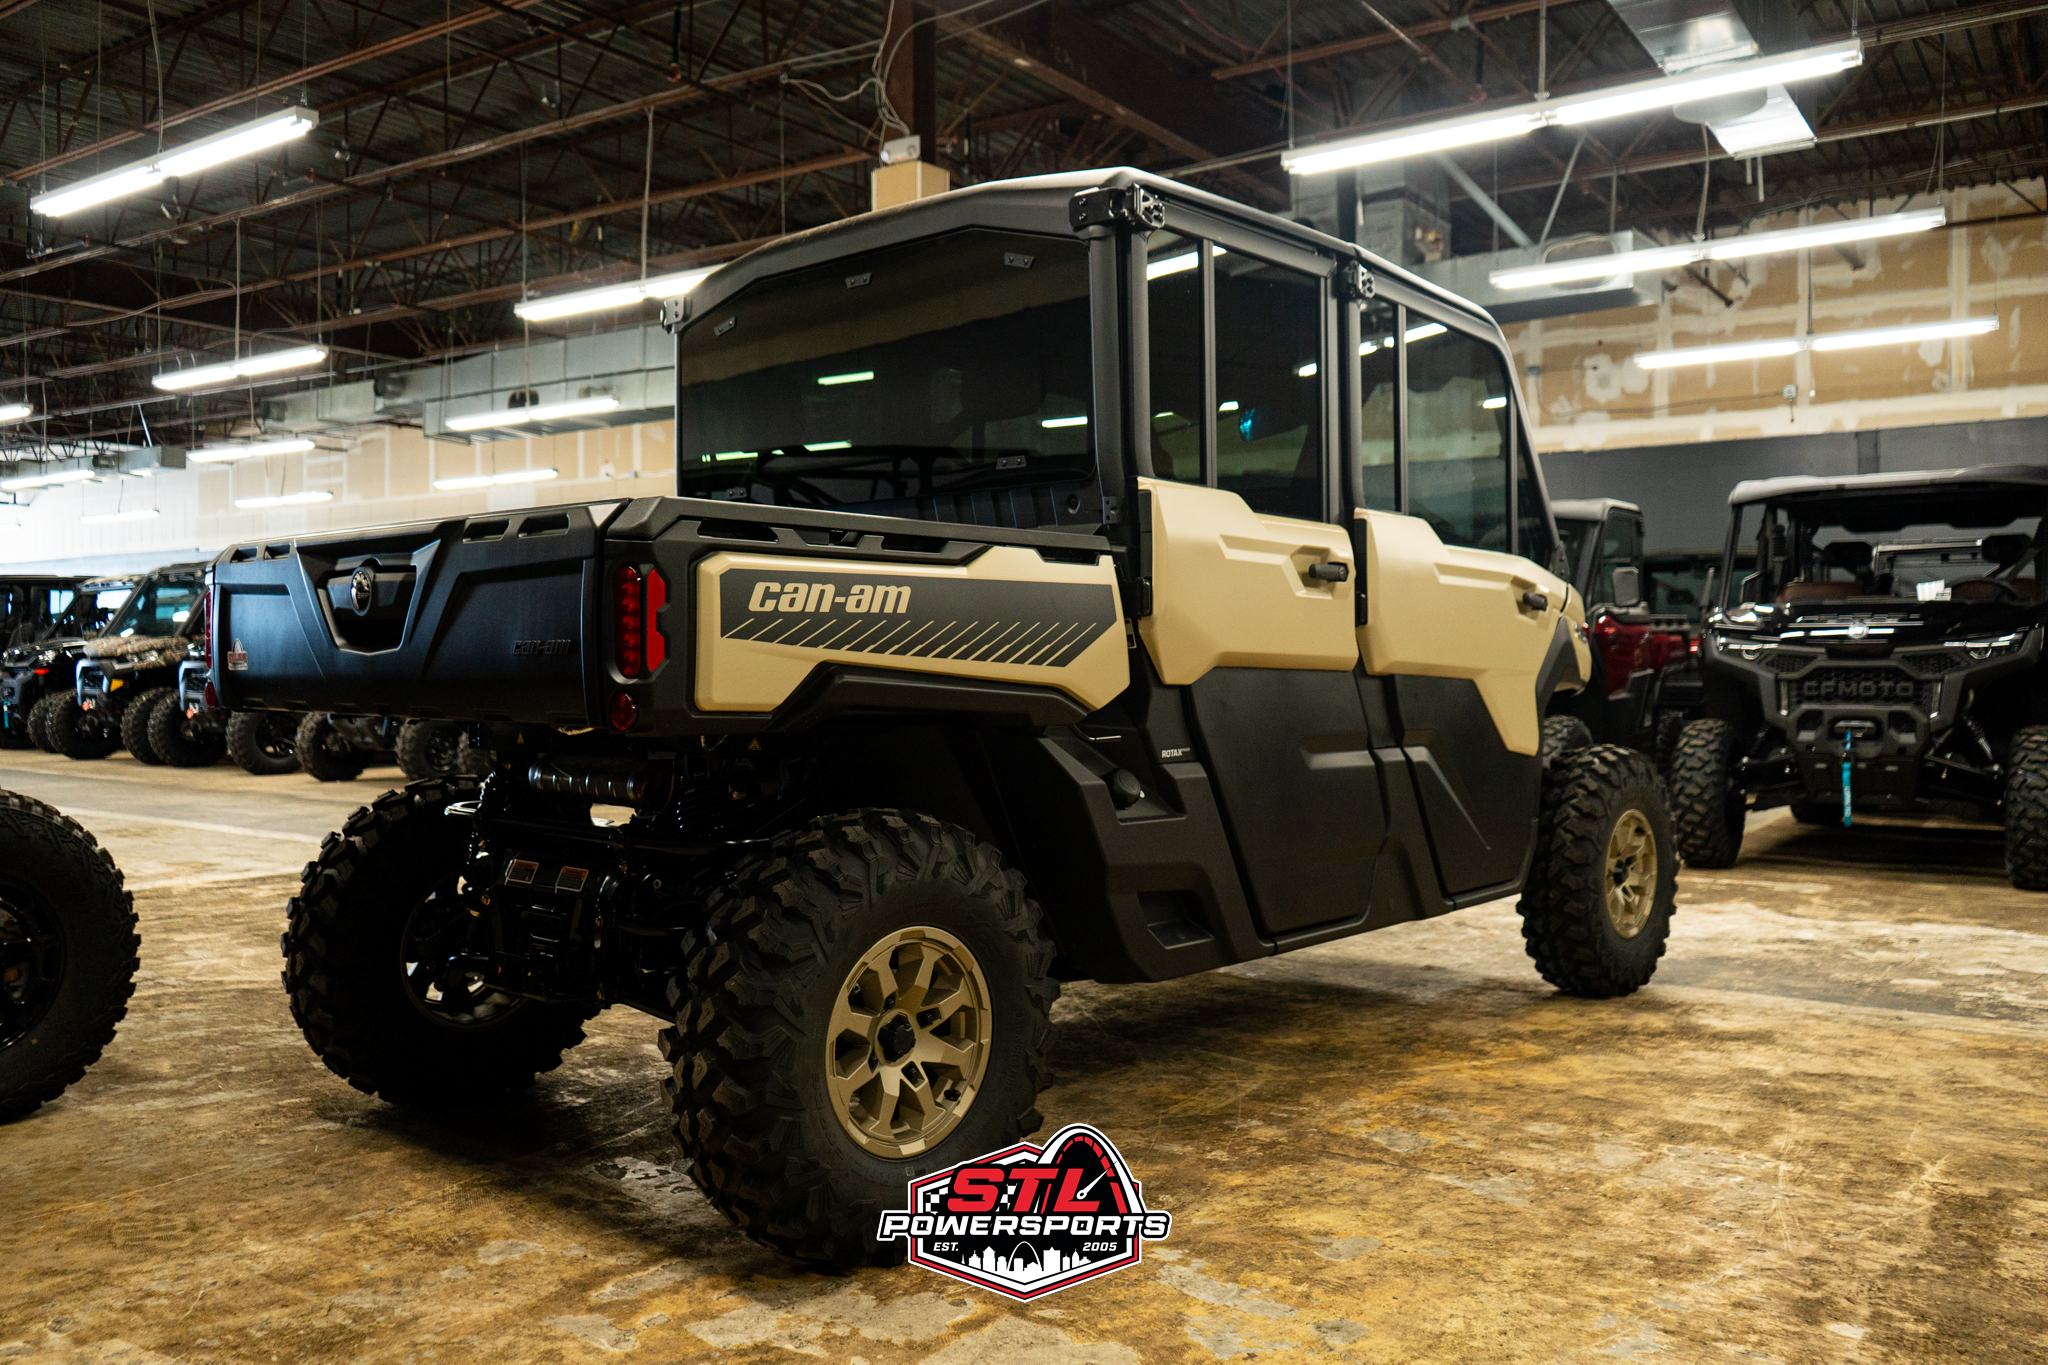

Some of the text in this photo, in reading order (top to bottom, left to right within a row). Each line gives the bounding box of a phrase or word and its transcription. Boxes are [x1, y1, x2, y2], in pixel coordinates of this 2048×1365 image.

[748, 581, 911, 613] can-am
[1804, 680, 1915, 698] CFMOTO
[1161, 748, 1183, 758] ROTAX
